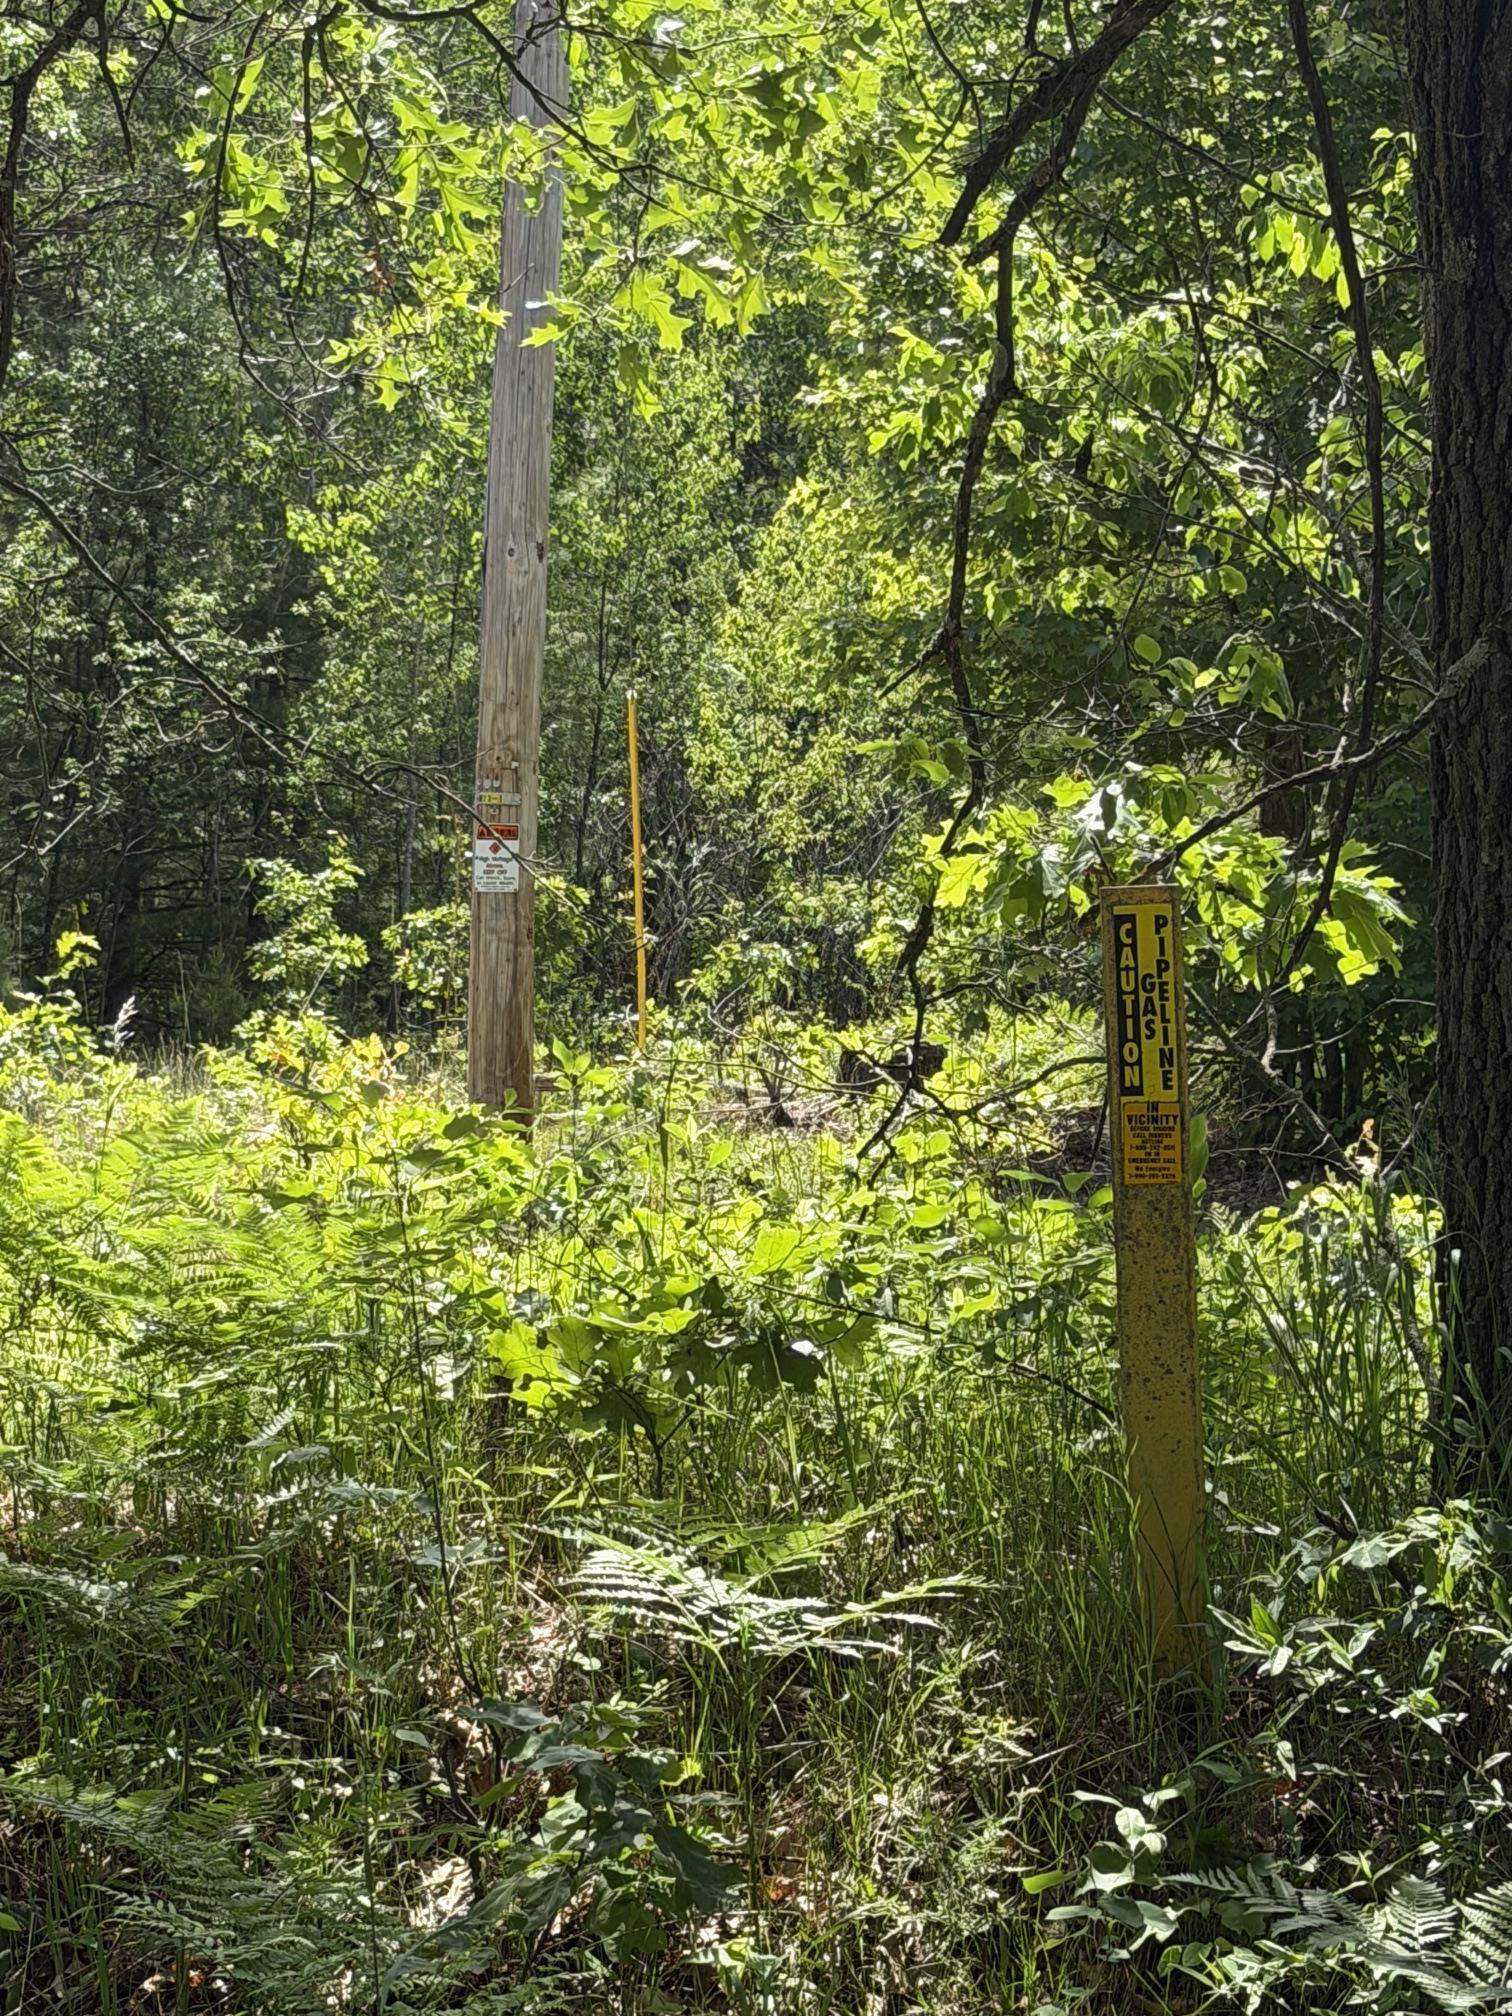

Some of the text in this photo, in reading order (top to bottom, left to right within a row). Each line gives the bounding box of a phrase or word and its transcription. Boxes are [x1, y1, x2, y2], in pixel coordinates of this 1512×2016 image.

[1119, 921, 1140, 1088] CAUTION
[1140, 972, 1158, 1041] GAS
[1154, 914, 1175, 1091] PIPELINE
[1127, 1114, 1178, 1125] VICINITY
[1146, 1102, 1159, 1113] IN
